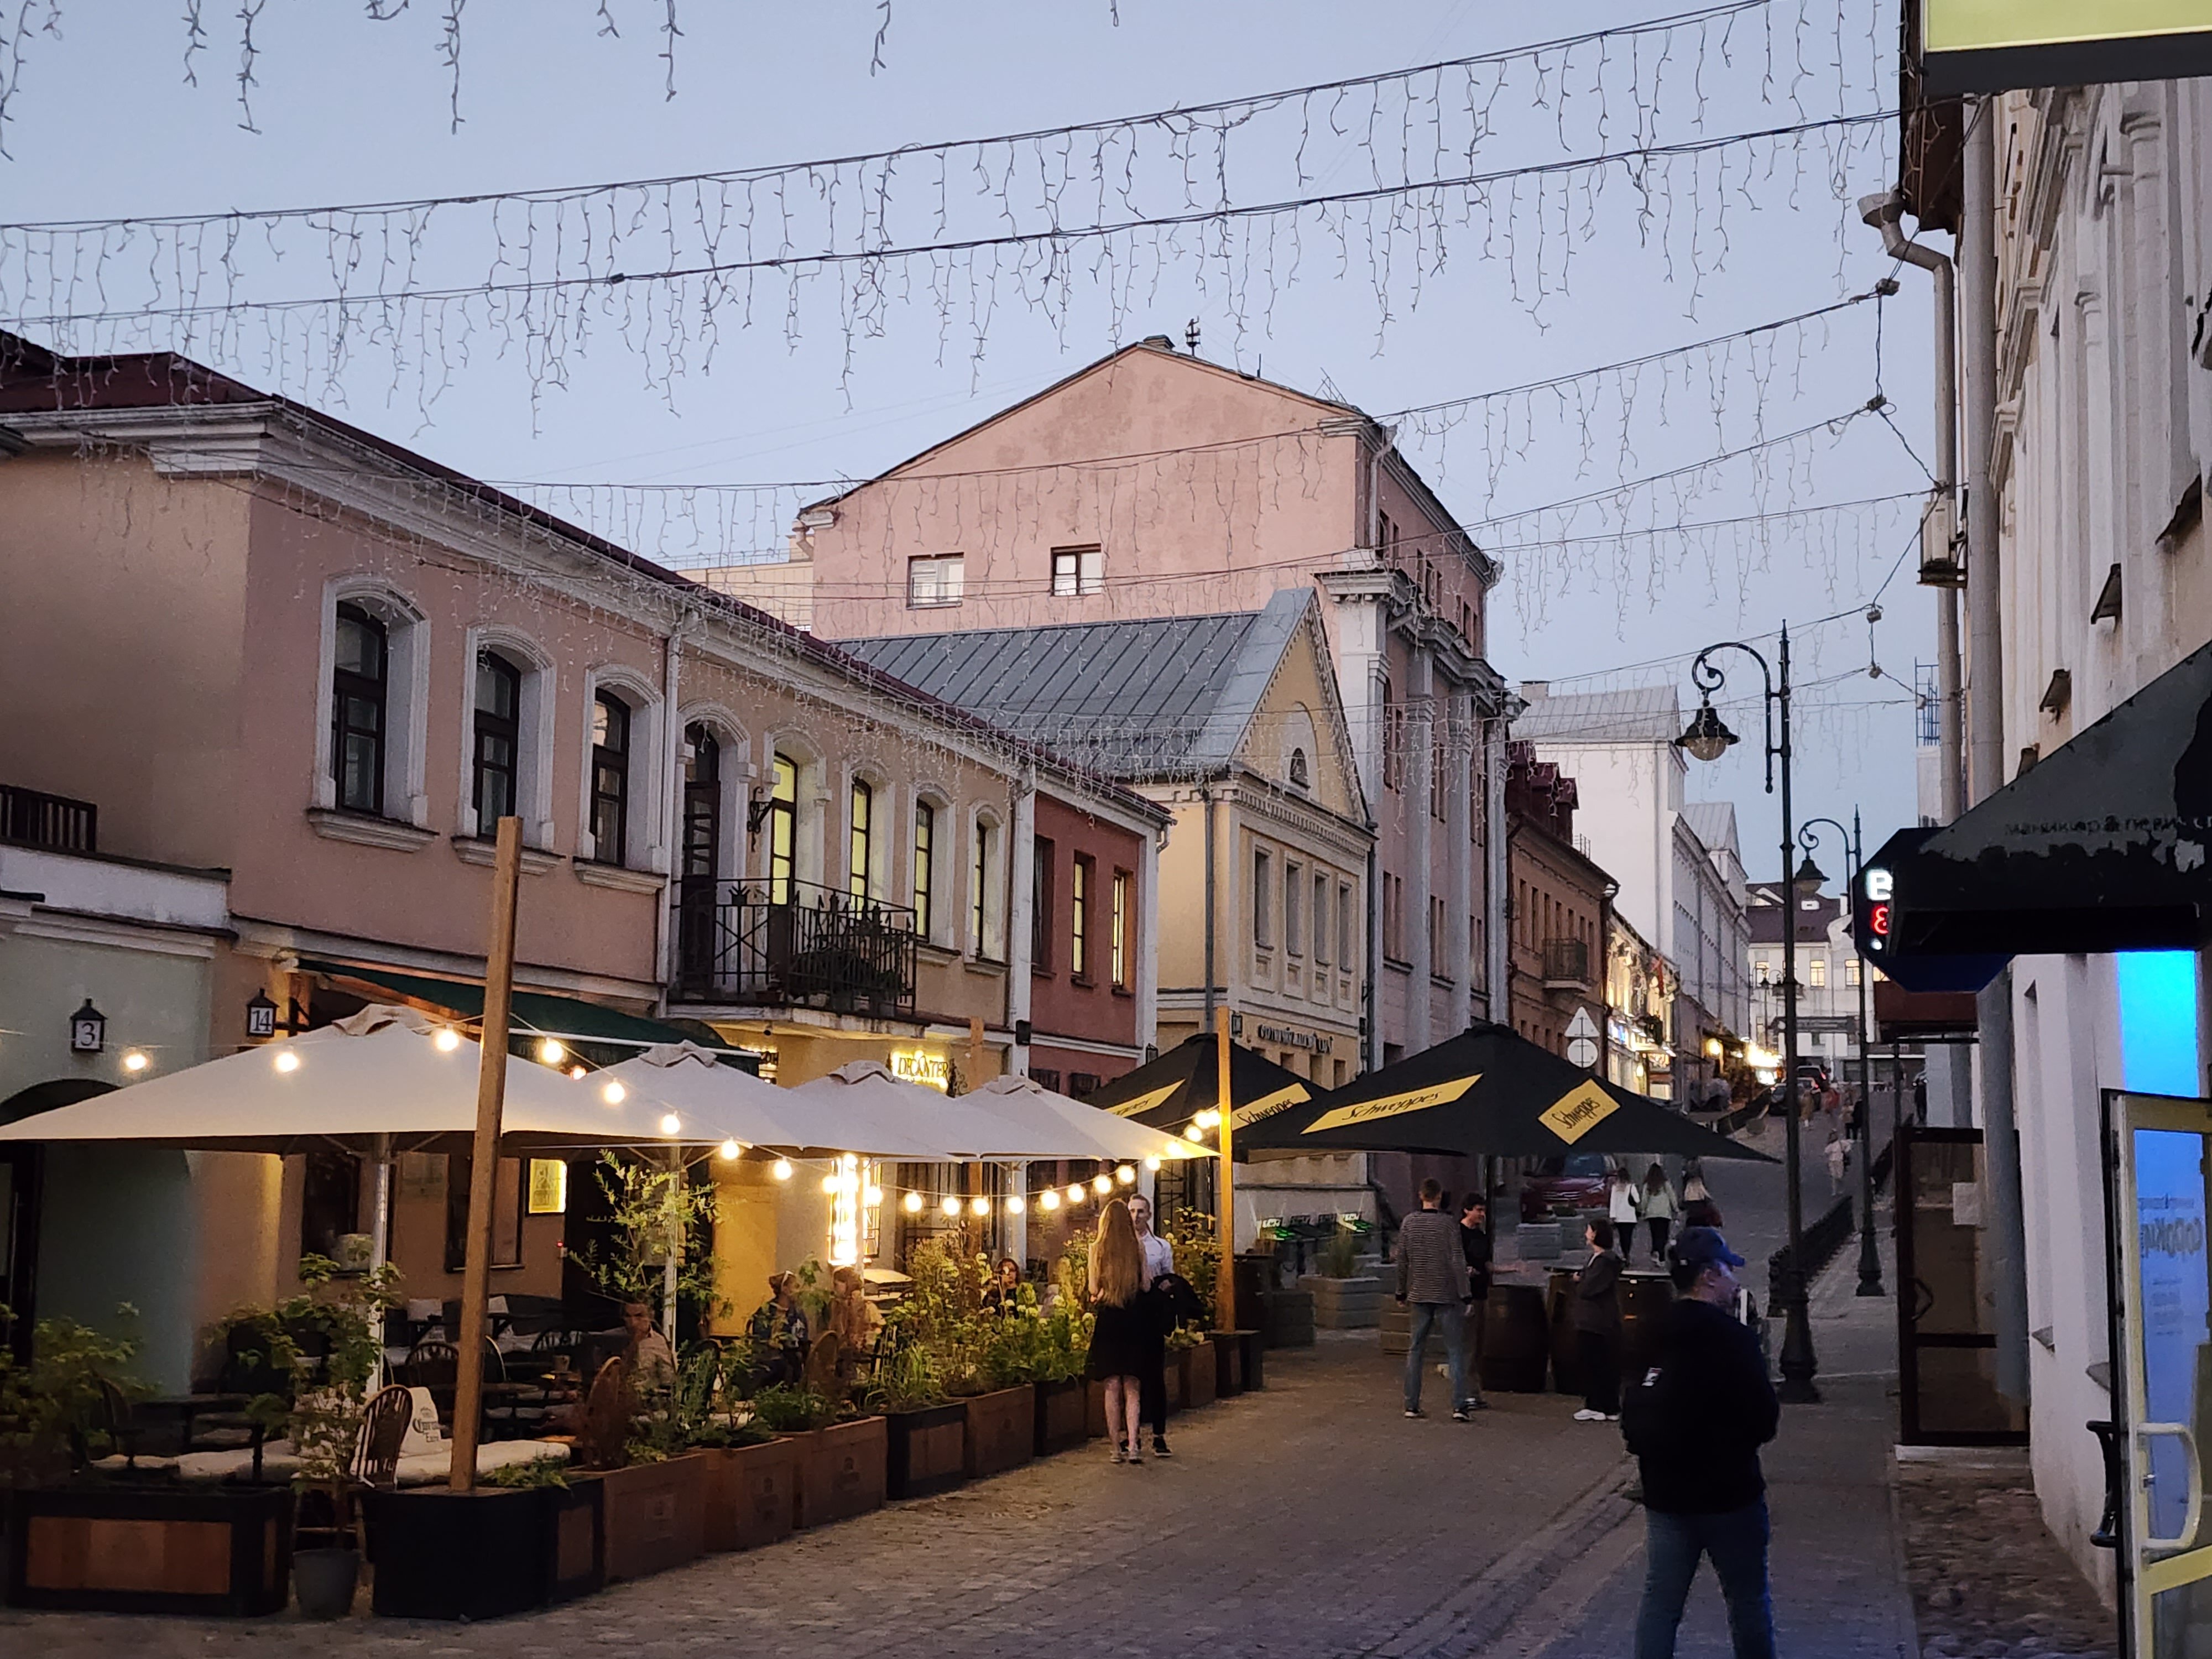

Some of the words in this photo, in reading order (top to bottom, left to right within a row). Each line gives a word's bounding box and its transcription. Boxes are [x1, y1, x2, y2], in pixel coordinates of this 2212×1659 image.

[81, 1022, 96, 1046] 3
[252, 1010, 272, 1032] 14
[1341, 1091, 1442, 1120] Schweppes
[1551, 1097, 1601, 1129] Schweppes
